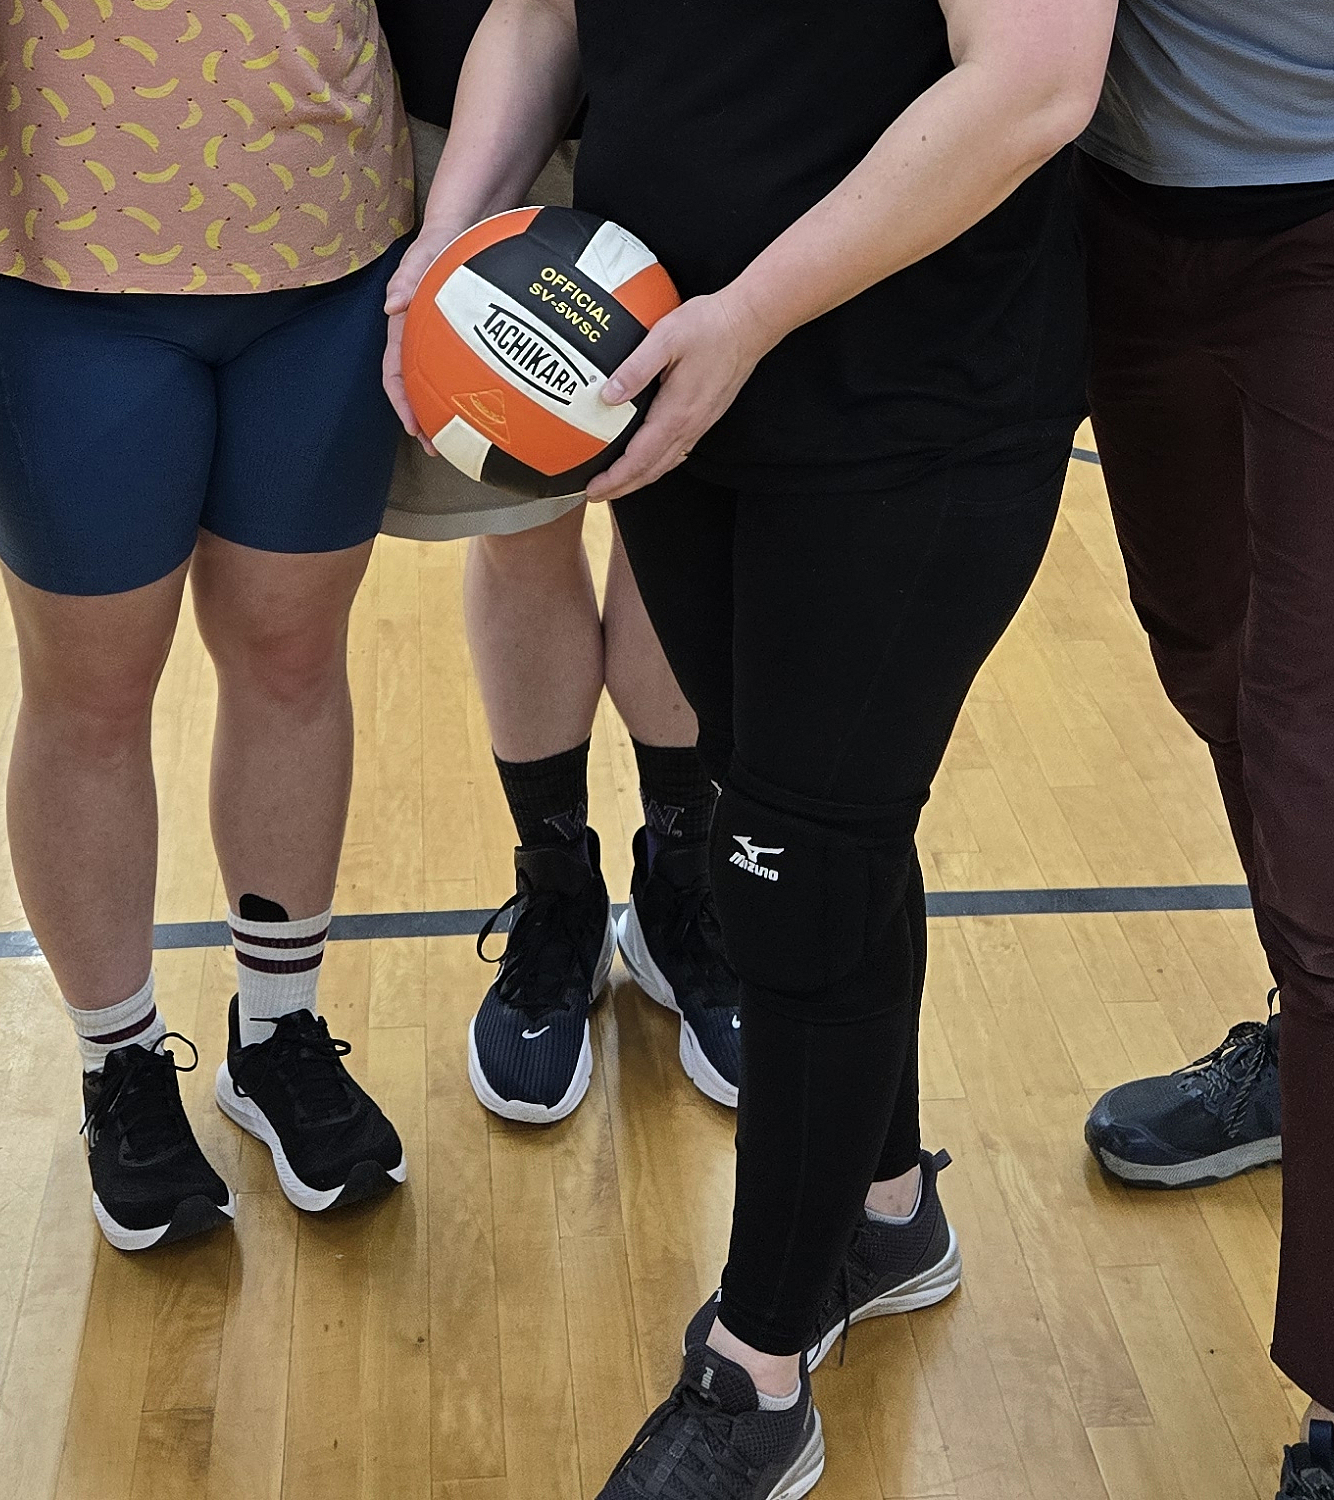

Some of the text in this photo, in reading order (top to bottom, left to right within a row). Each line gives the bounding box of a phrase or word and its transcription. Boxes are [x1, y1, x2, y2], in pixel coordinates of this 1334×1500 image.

[529, 282, 601, 344] SV-5WSC
[540, 266, 610, 332] OFFICIAL
[482, 303, 579, 397] TACHIKARA
